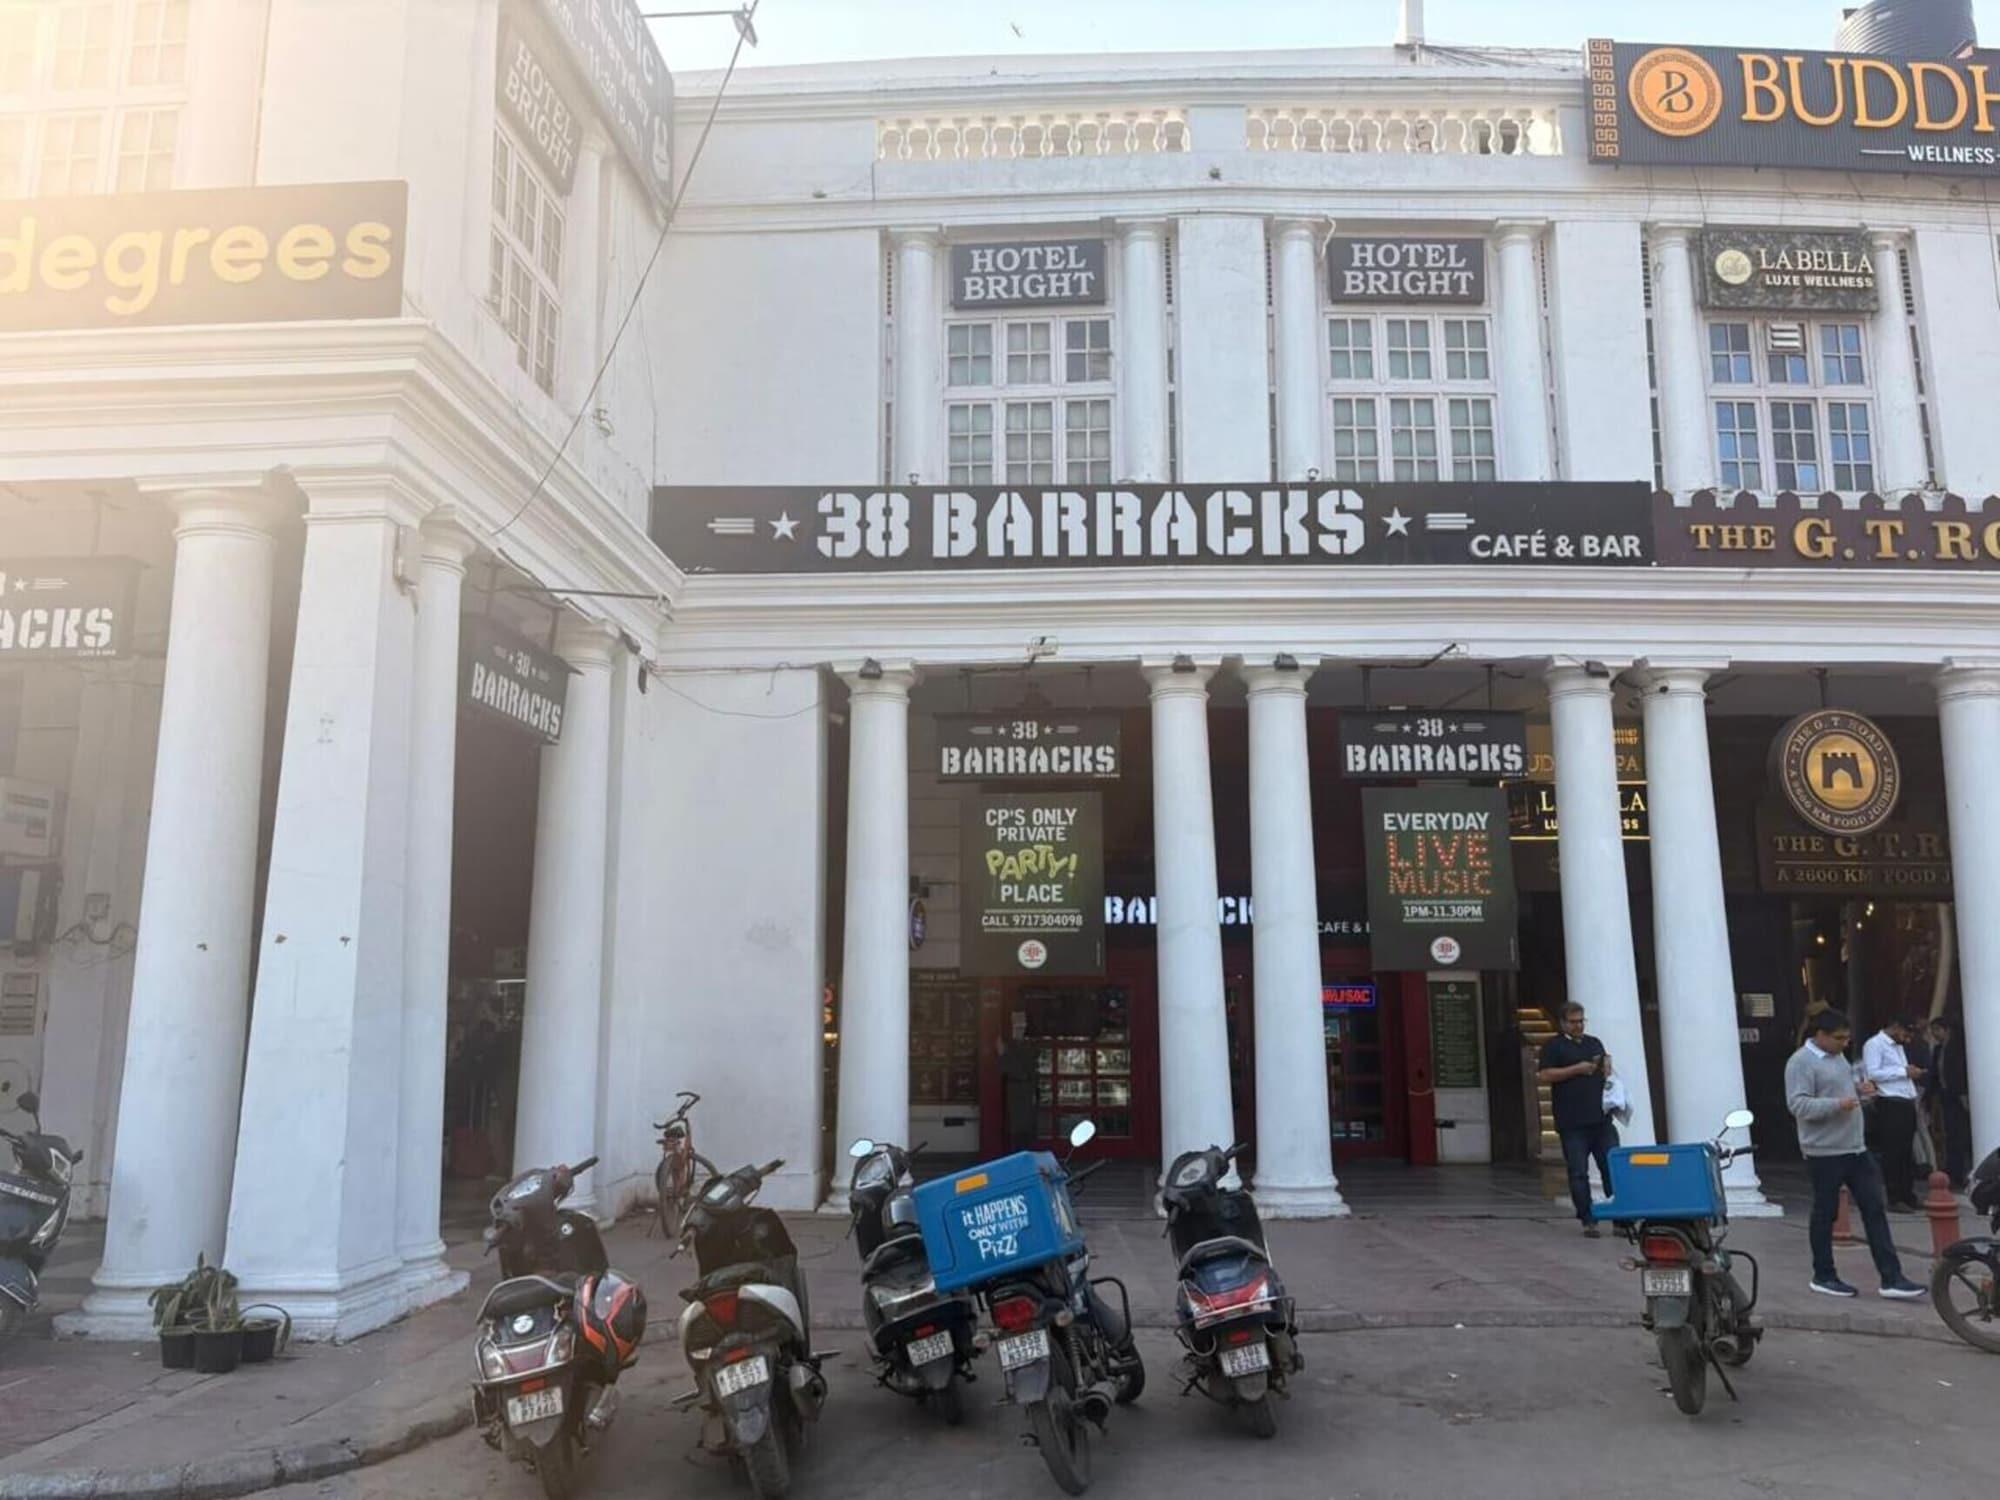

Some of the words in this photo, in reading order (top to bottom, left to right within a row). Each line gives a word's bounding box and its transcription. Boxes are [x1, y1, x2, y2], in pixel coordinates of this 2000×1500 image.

[516, 40, 573, 145] HOTEL
[505, 65, 573, 178] BRIGHT
[1908, 144, 1995, 164] WELLNESS
[970, 245, 1087, 273] HOTEL
[1351, 243, 1467, 268] HOTEL
[963, 272, 1095, 300] BRIGHT
[1343, 270, 1475, 295] BRIGHT
[1765, 274, 1800, 286] LUXE
[1804, 275, 1874, 288] WELLNESS
[817, 492, 910, 558] 38
[932, 488, 1365, 558] BARRACKS
[1470, 529, 1547, 558] CAFÉ
[1554, 535, 1575, 558] &
[1583, 534, 1642, 558] BAR
[1690, 524, 1776, 550] THE
[472, 661, 561, 736] BARRACKS
[1012, 720, 1039, 740] 38
[1417, 718, 1443, 737] 38
[941, 745, 1116, 774] BARRACKS
[1346, 744, 1523, 772] BARRACKS
[986, 808, 1026, 827] CP'S
[1032, 807, 1078, 826] ONLY
[1383, 811, 1490, 831] EVERYDAY
[997, 826, 1067, 842] PRIVATE
[1774, 836, 1824, 852] THE
[1386, 833, 1492, 870] LIVE
[1000, 884, 1064, 903] PLACE
[1387, 870, 1493, 896] MUSIC
[981, 915, 1009, 927] CALL
[1012, 914, 1083, 927] 9717304098
[974, 1195, 1028, 1225] HAPPENS
[968, 1224, 997, 1240] ONLY
[999, 1216, 1029, 1232] WITH
